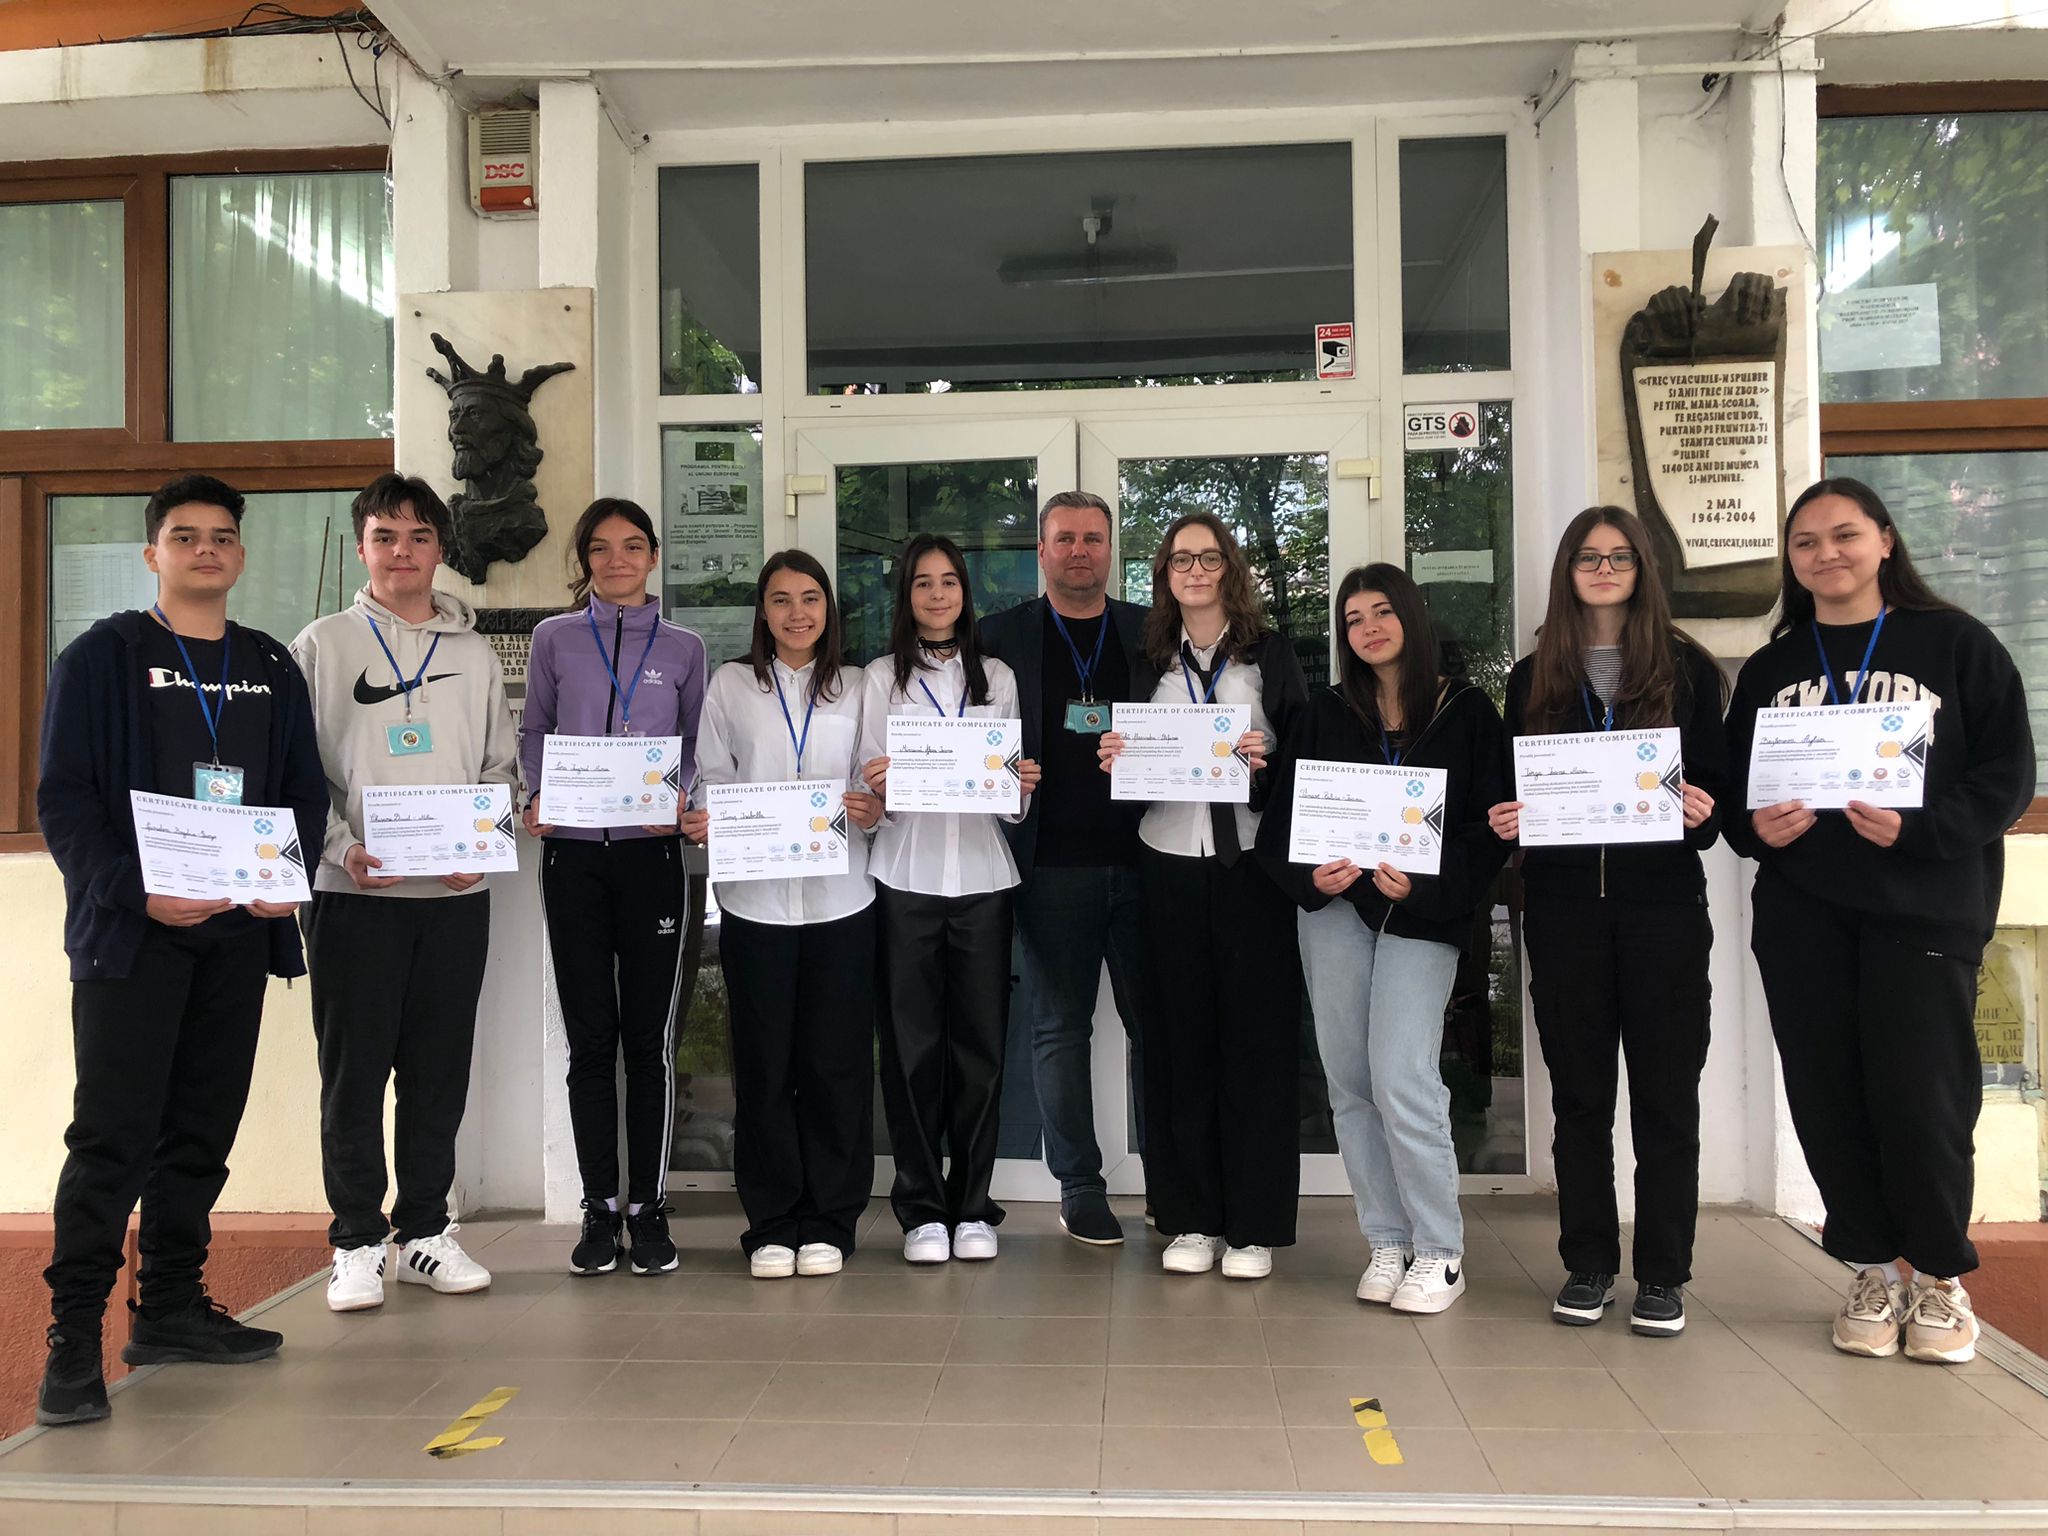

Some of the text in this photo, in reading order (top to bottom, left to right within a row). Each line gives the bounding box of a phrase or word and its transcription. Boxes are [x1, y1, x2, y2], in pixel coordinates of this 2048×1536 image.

[485, 163, 524, 179] DSC
[1319, 328, 1331, 337] 24
[1730, 372, 1768, 383] SPULBER
[1678, 388, 1698, 397] ANII
[1700, 388, 1722, 397] TREC
[1723, 387, 1733, 396] IN
[1654, 401, 1663, 411] PE
[1674, 411, 1763, 422] TE REGASIM CU DOR,
[1408, 416, 1446, 431] GTS
[1660, 425, 1703, 436] PURTAND
[1703, 424, 1713, 434] PE
[1680, 435, 1768, 447] SFANTA CUNUNA DE
[1680, 450, 1710, 460] IUBIRE
[1662, 460, 1759, 473] SI 40 DE ANI DE MUNCA
[1707, 498, 1741, 510] 2 MAI
[1692, 512, 1756, 523] 1964-2004
[643, 677, 663, 685] adidas
[1761, 710, 1825, 719] CERTIFICATE
[1844, 705, 1911, 715] COMPLETION
[548, 740, 601, 748] CERTIFICATE
[1519, 737, 1581, 747] CERTIFICATE
[1599, 732, 1662, 742] COMPLETION
[1300, 764, 1357, 774] CERTIFICATE
[1373, 768, 1431, 778] COMPLETION
[366, 790, 424, 798] CERTIFICATE
[440, 787, 495, 795] COMPLETION
[711, 786, 764, 795] CERTIFICATE
[780, 783, 831, 792] COMPLETION
[136, 795, 277, 817] CERTIFICATE OF COMPLETION
